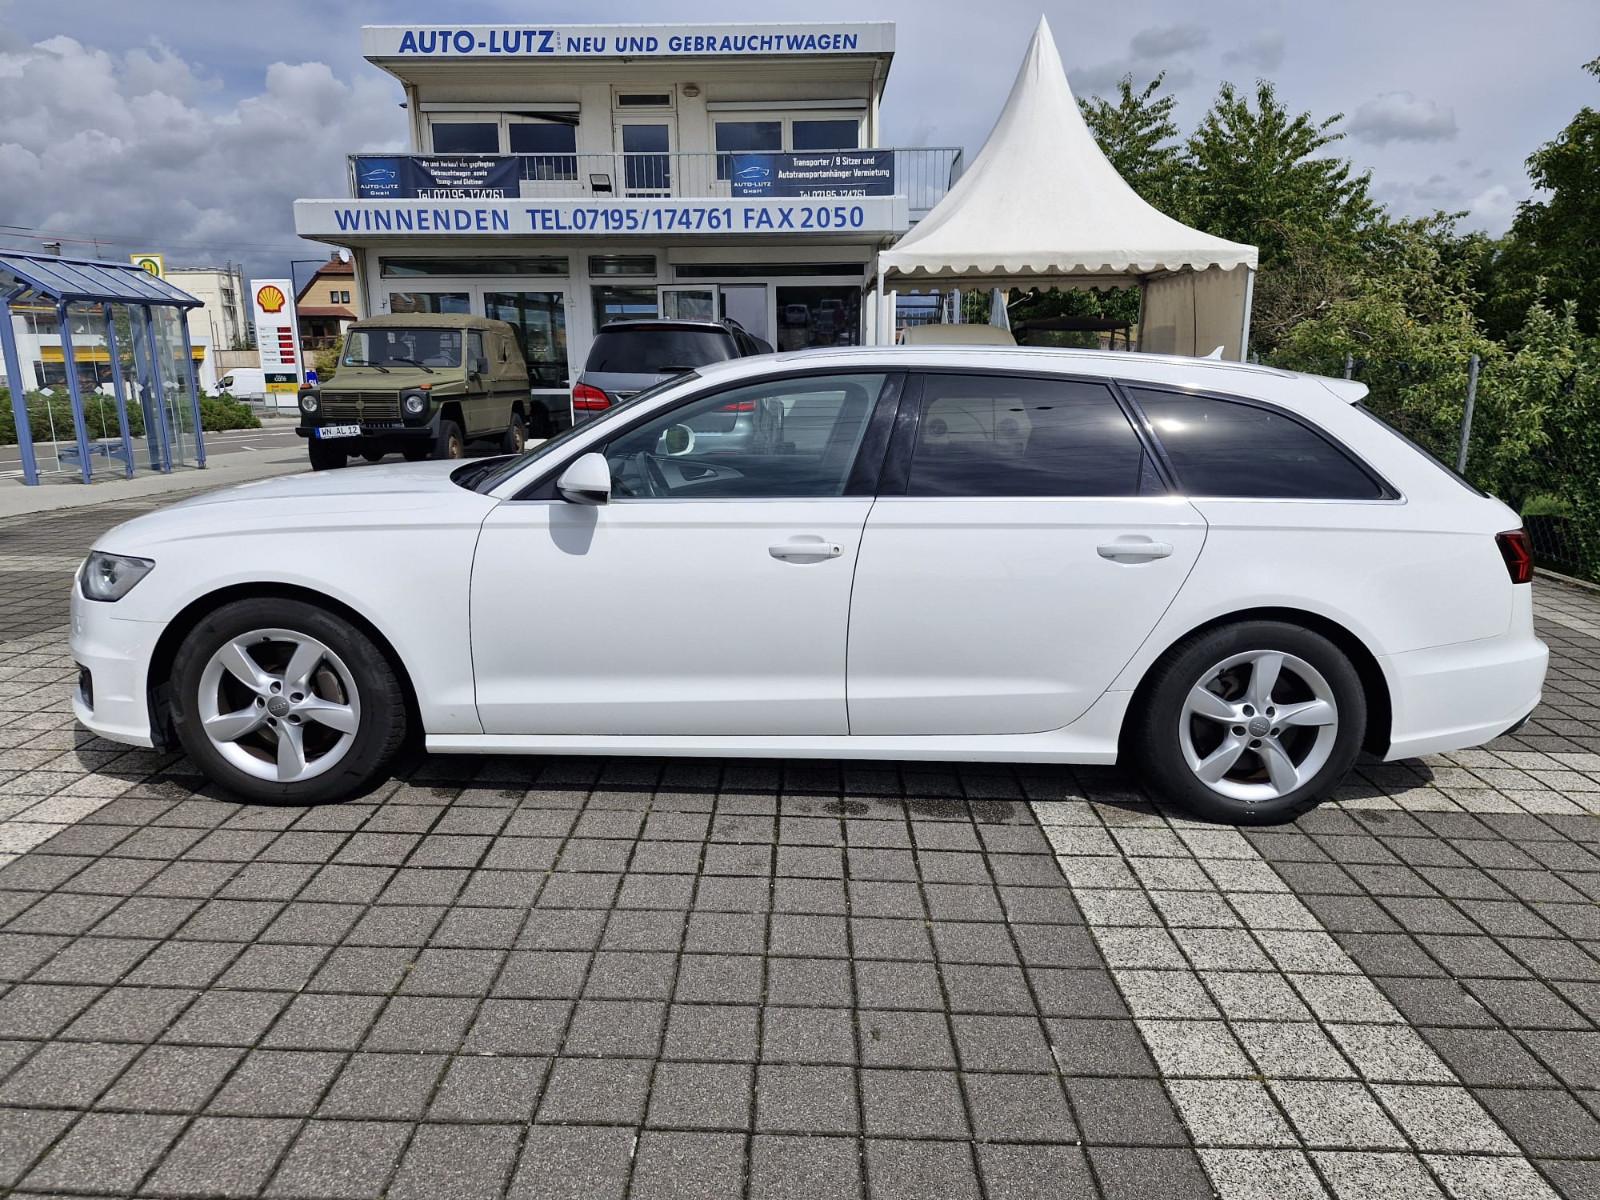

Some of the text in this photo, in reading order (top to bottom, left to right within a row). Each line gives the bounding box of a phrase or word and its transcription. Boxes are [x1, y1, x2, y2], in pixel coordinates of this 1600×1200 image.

[399, 30, 858, 53] AUTO-LUTZ NEU UND GEBRAUCHTWAGEN
[792, 157, 829, 167] Transporter
[835, 157, 840, 165] 9
[842, 156, 861, 165] Sitzer
[863, 156, 874, 165] und
[430, 169, 471, 177] Gebrauchtwagen
[778, 168, 890, 179] Autotransportanhänger Vermietung
[334, 209, 509, 231] WINNENDEN
[321, 426, 358, 436] WN AL 12
